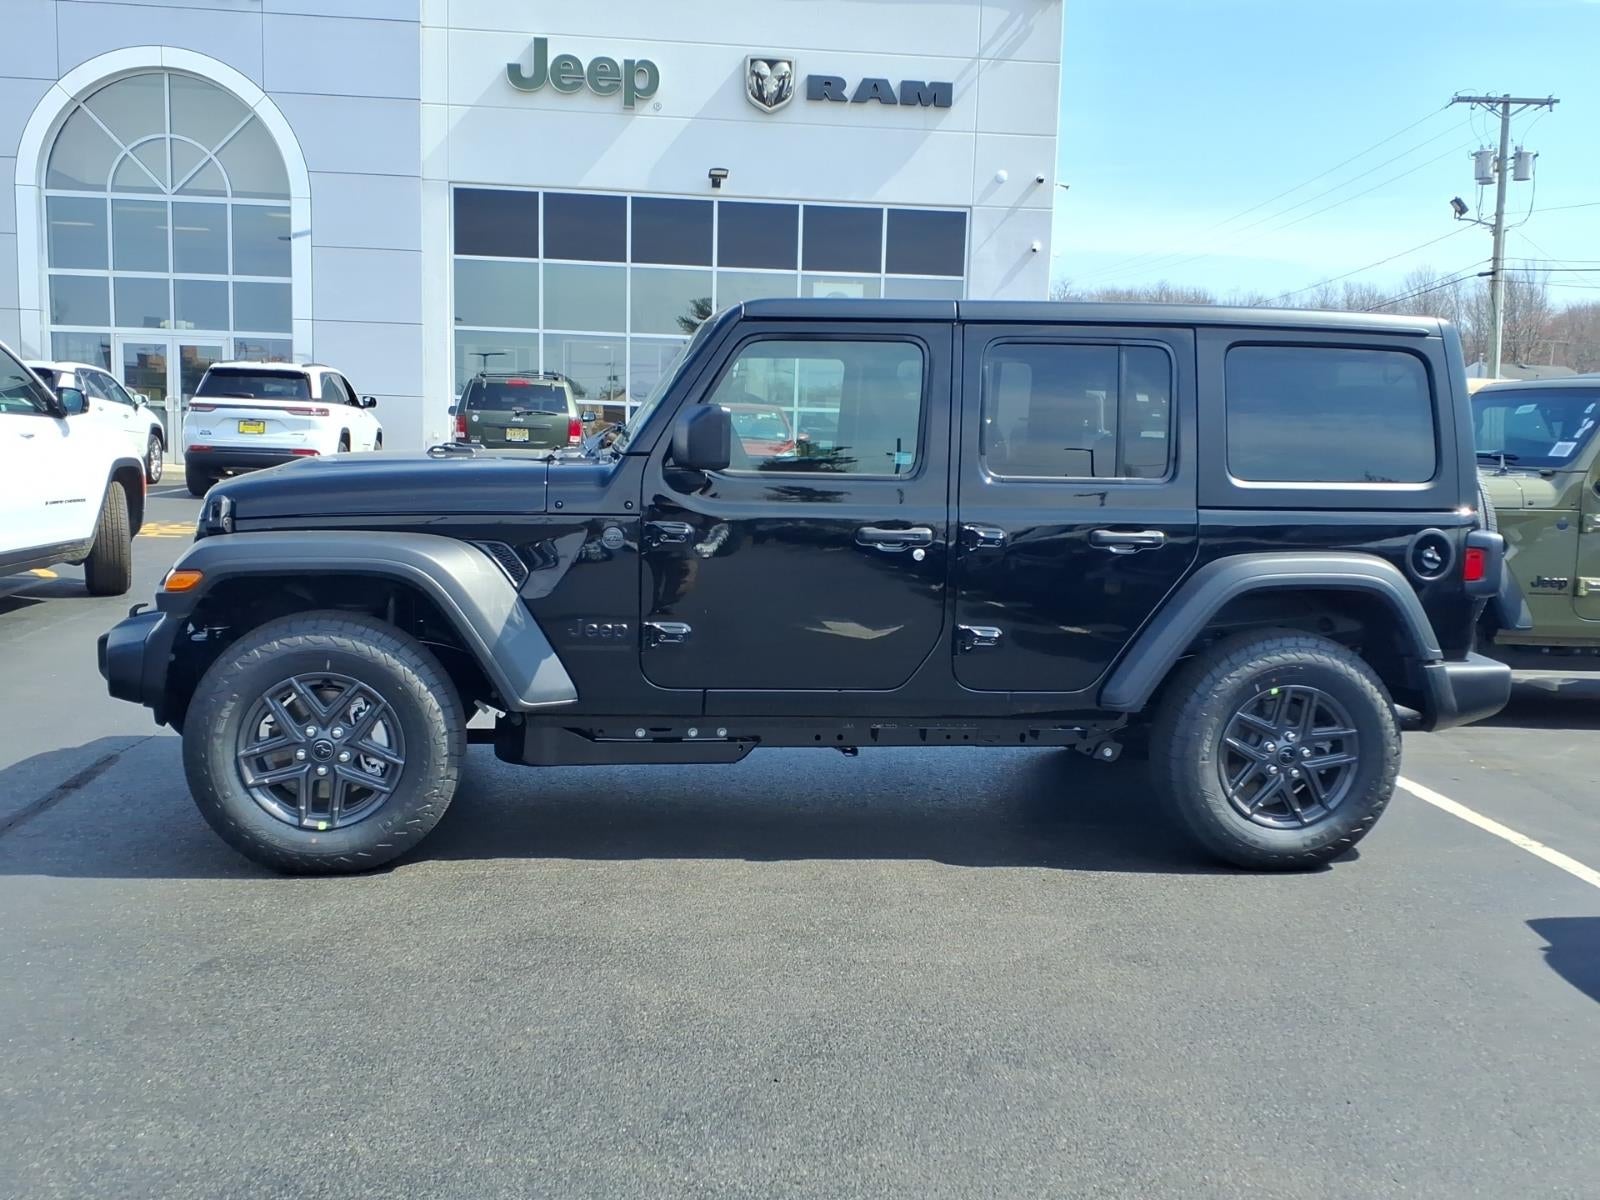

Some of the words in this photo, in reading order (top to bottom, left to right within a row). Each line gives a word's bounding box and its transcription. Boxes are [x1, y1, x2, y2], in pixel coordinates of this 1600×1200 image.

[507, 37, 660, 110] Jeep
[806, 74, 953, 108] RAM
[1530, 575, 1568, 590] Jeep
[567, 618, 629, 640] Jeep
